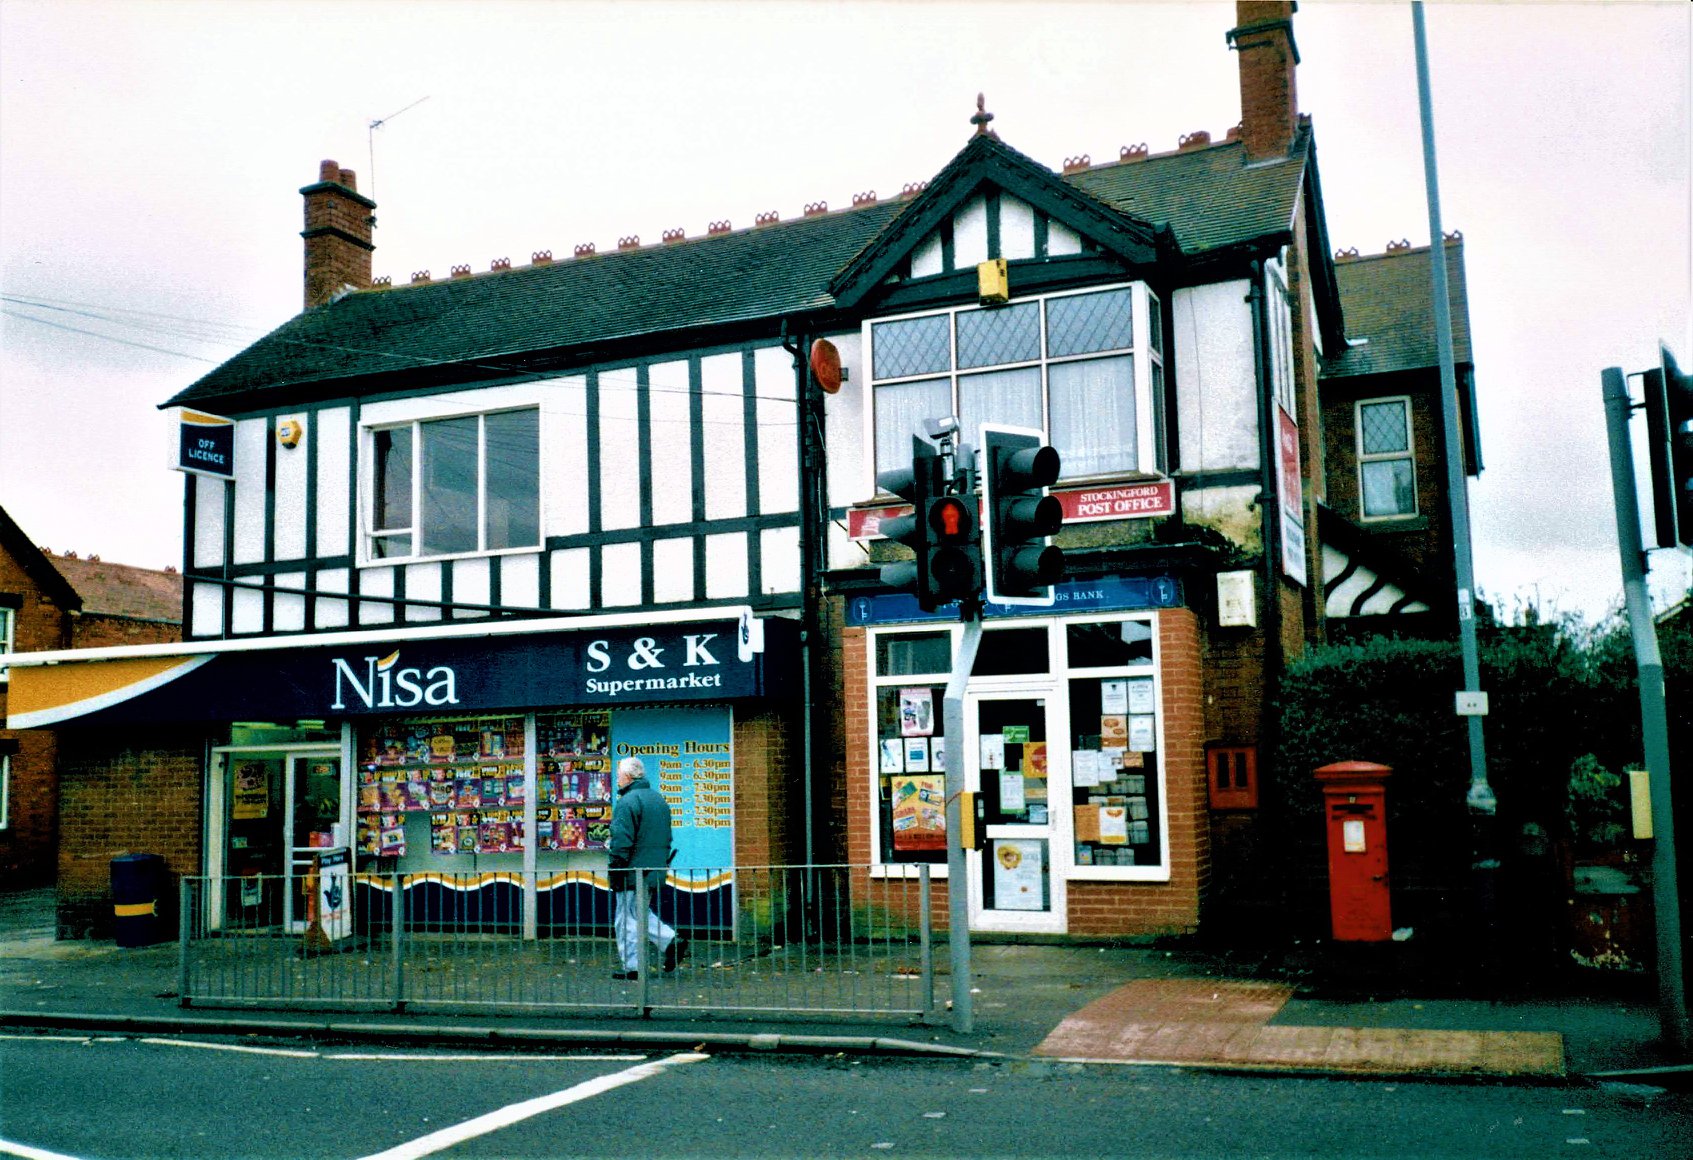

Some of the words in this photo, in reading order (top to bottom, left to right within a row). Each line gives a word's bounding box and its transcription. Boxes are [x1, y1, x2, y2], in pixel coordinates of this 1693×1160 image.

[198, 438, 215, 450] OFF
[188, 448, 225, 464] LICENCE
[1080, 486, 1159, 502] STOCKINGFORD
[1077, 502, 1112, 516] POST
[1114, 496, 1163, 512] OFFICE
[1073, 590, 1104, 600] BANK
[586, 640, 611, 672] S
[627, 637, 666, 670] &
[682, 633, 720, 667] K
[331, 649, 460, 709] Nisa
[586, 672, 721, 696] Supermarket
[617, 742, 679, 758] Opening
[684, 741, 730, 754] Hours
[660, 760, 682, 769] 9am
[693, 759, 730, 770] 6.30pm
[660, 771, 682, 780] 9am
[693, 771, 730, 781] 6.30pm
[660, 783, 682, 792] 9am
[694, 783, 731, 793] 7.30pm
[694, 794, 731, 805] 7.30pm
[694, 806, 731, 816] 7.30pm
[694, 818, 731, 828] 7.30pm
